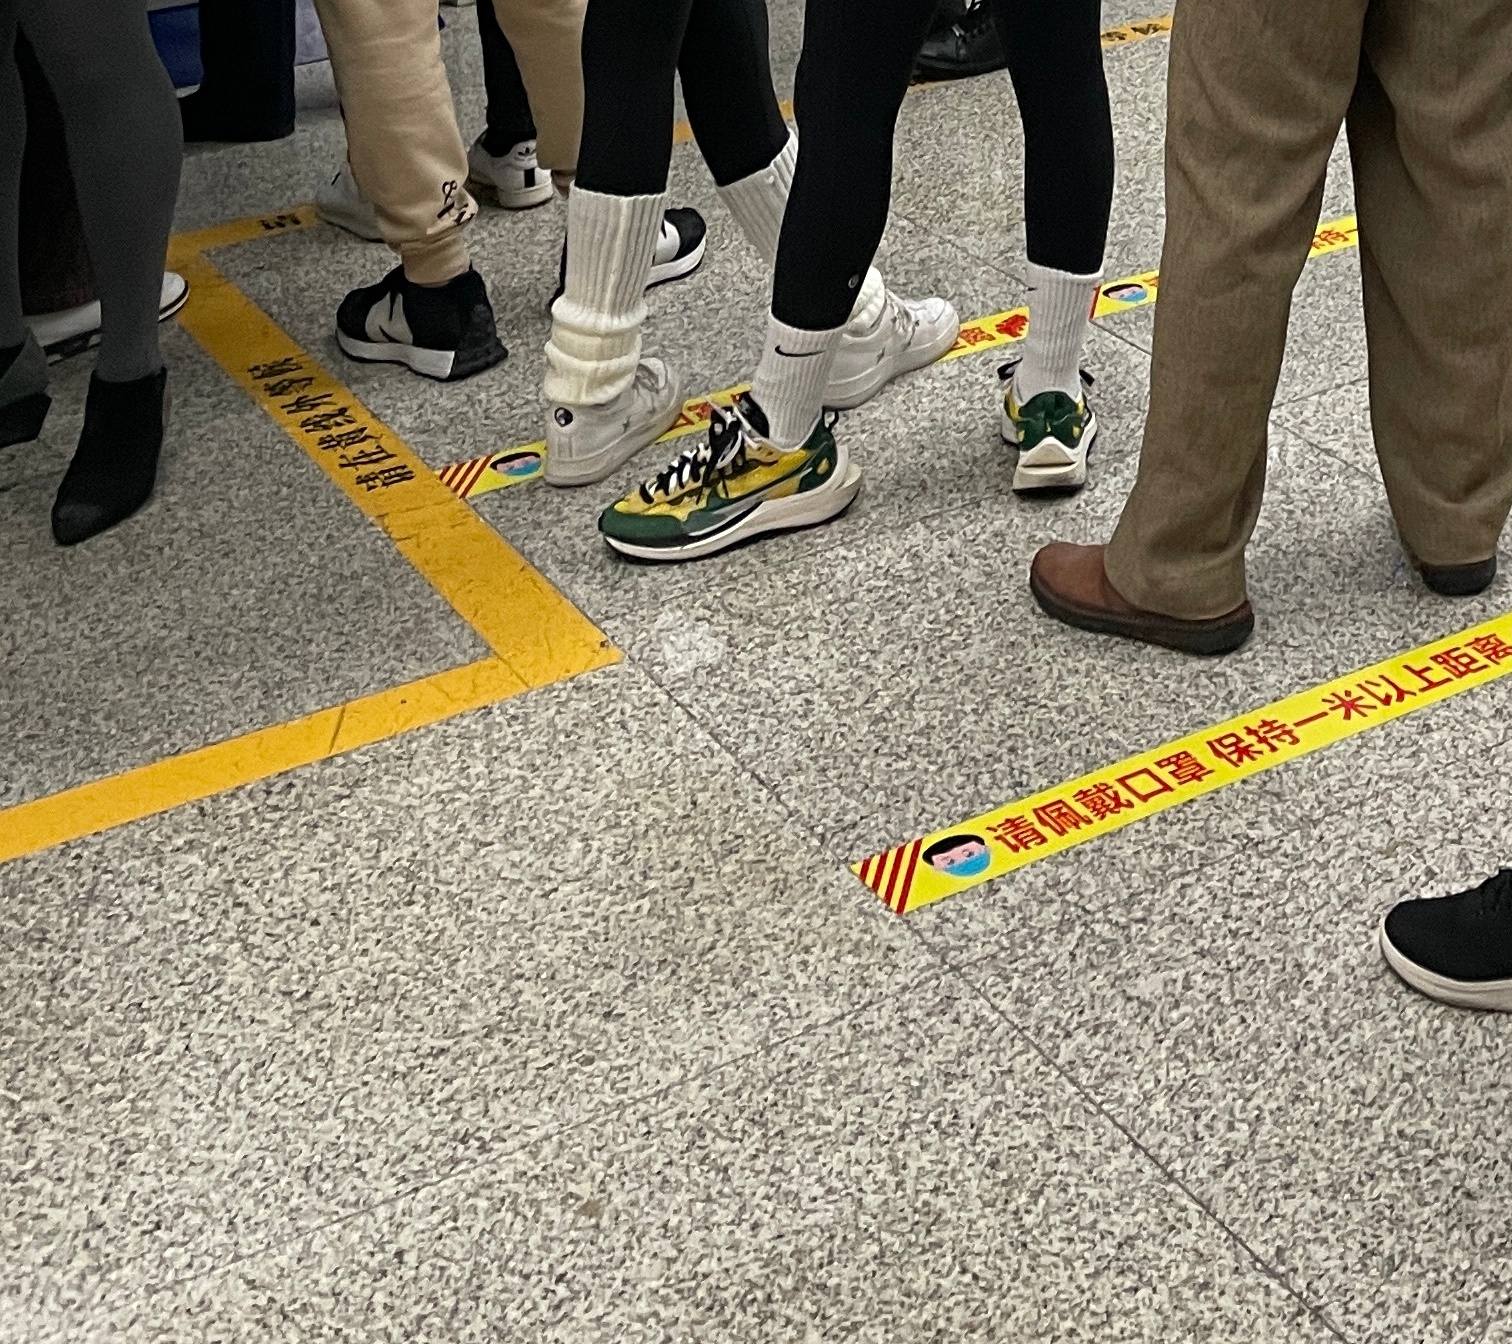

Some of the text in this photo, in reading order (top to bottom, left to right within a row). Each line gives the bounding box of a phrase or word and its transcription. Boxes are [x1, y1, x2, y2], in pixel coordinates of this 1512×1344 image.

[989, 749, 1215, 854] 请佩戴口罩
